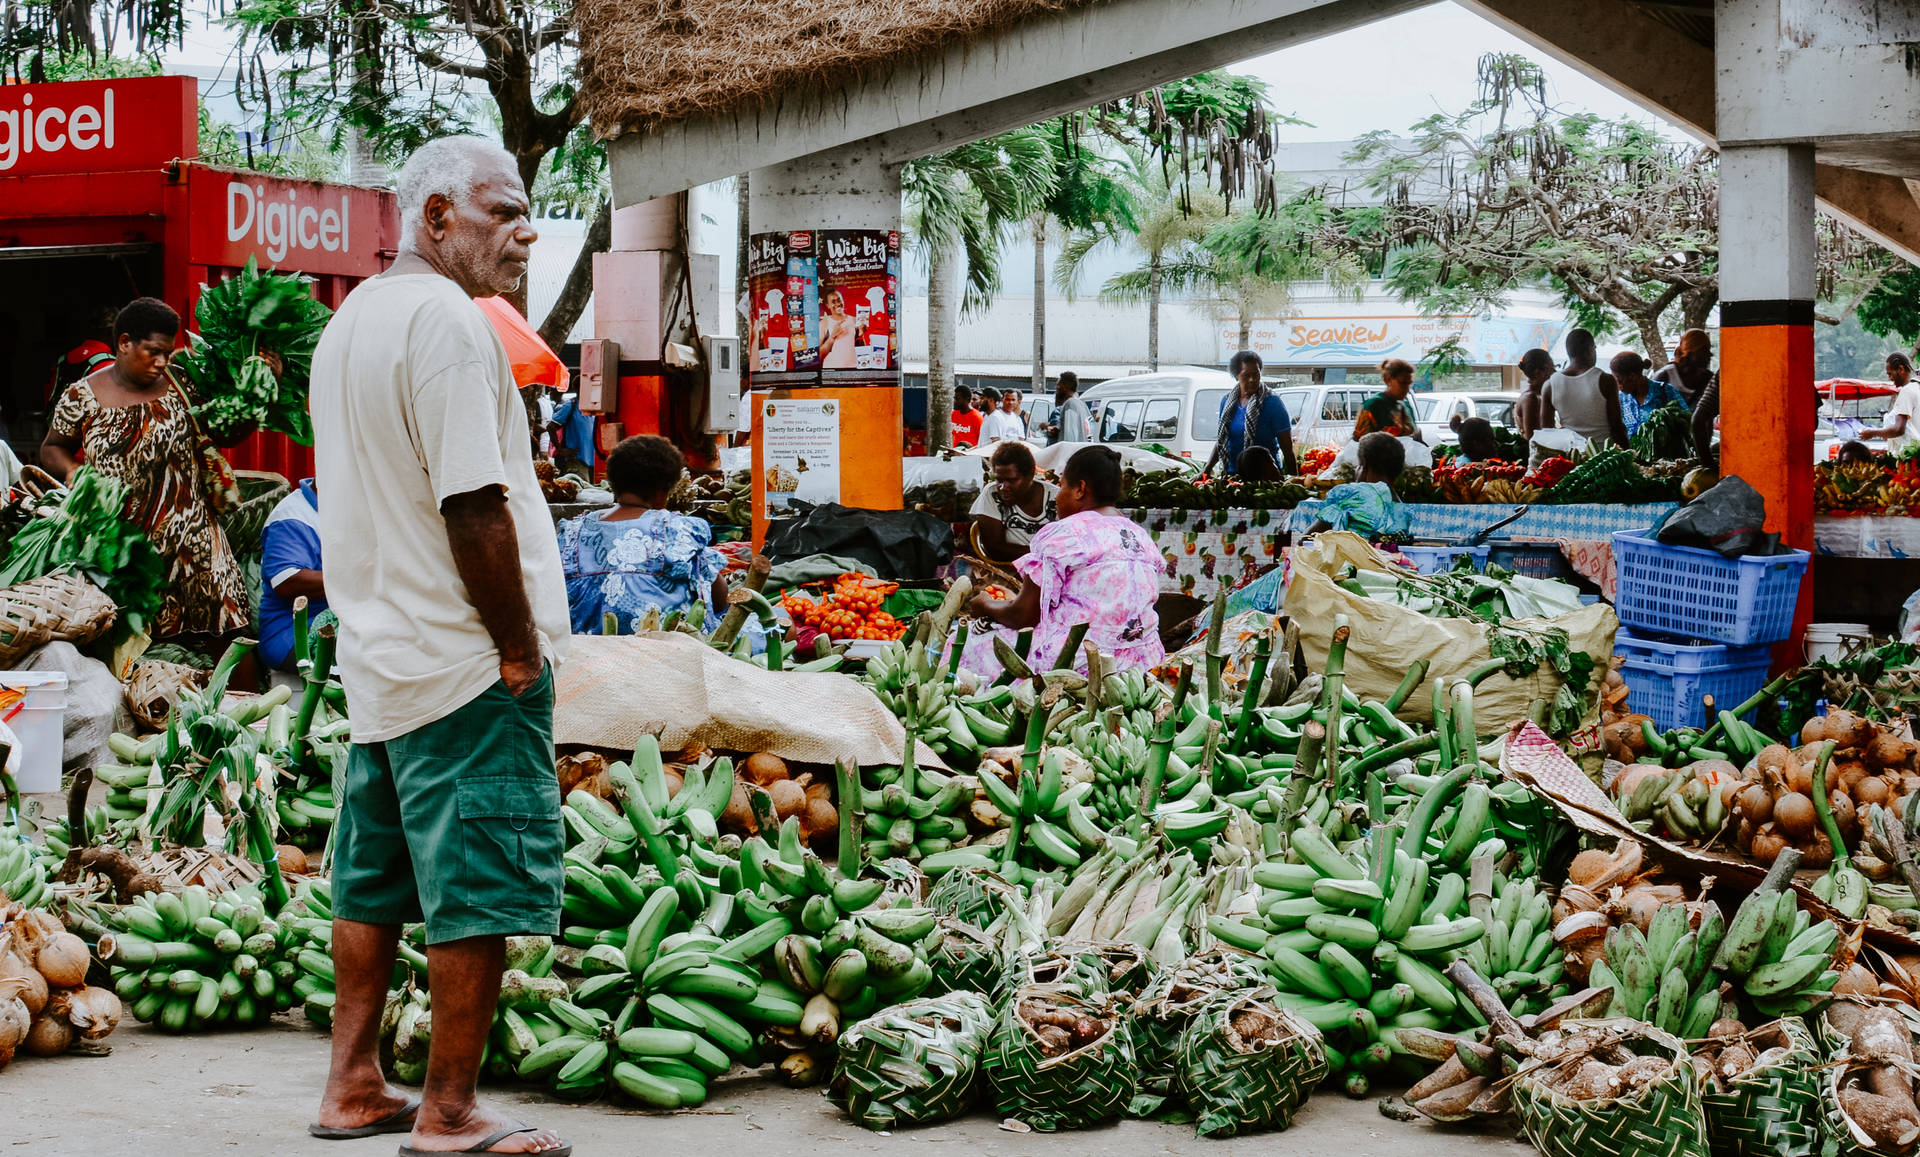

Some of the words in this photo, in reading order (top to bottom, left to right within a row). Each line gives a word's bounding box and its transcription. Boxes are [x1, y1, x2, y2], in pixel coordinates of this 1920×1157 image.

[227, 181, 349, 263] Digicel
[763, 239, 786, 265] Big
[827, 238, 861, 259] Win
[863, 236, 888, 263] Big
[1256, 330, 1276, 340] days
[1288, 322, 1388, 347] Seaview
[1412, 322, 1435, 331] roast
[1254, 341, 1273, 351] 9pm
[1413, 334, 1433, 344] juicy
